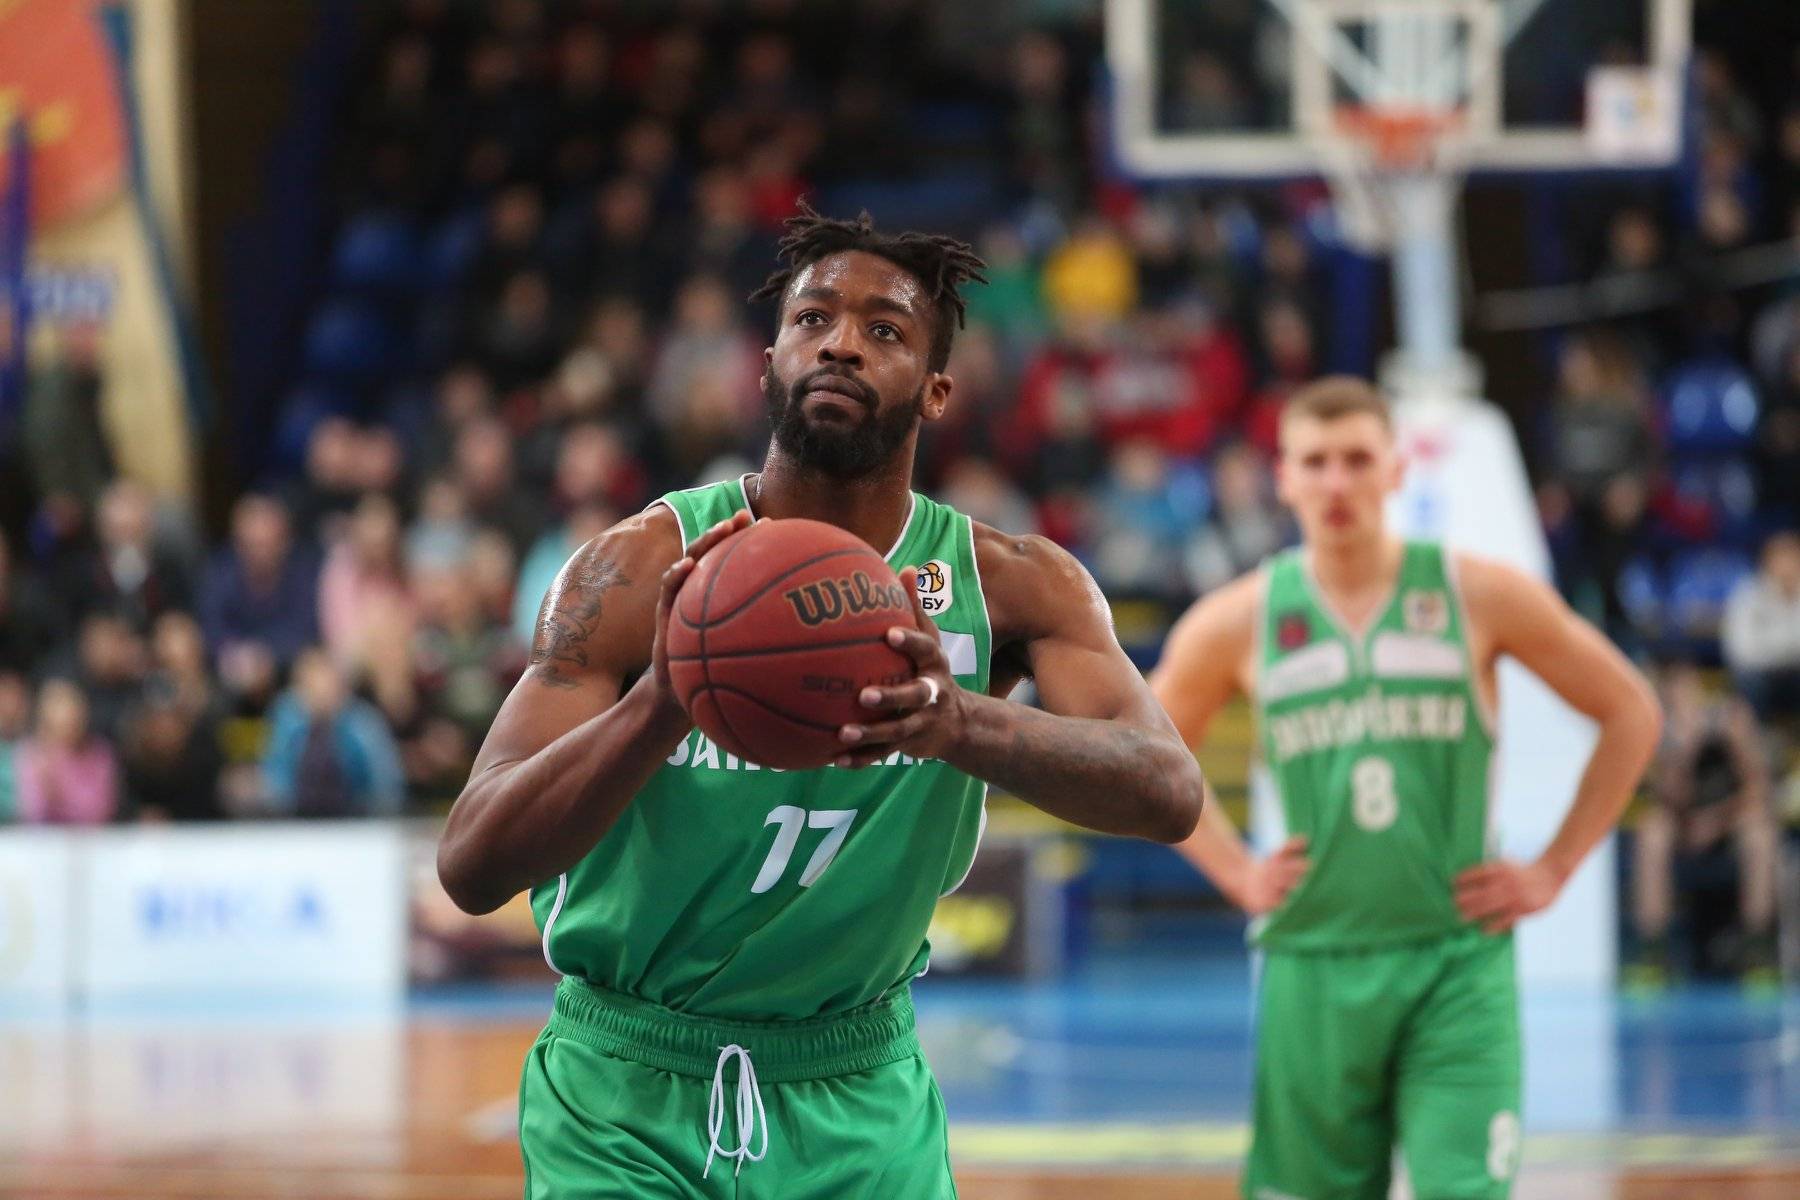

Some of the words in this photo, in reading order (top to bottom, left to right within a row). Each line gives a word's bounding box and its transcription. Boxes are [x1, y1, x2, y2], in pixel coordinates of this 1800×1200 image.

[918, 597, 944, 610] БУ
[1352, 756, 1397, 832] 8
[750, 804, 858, 894] 17
